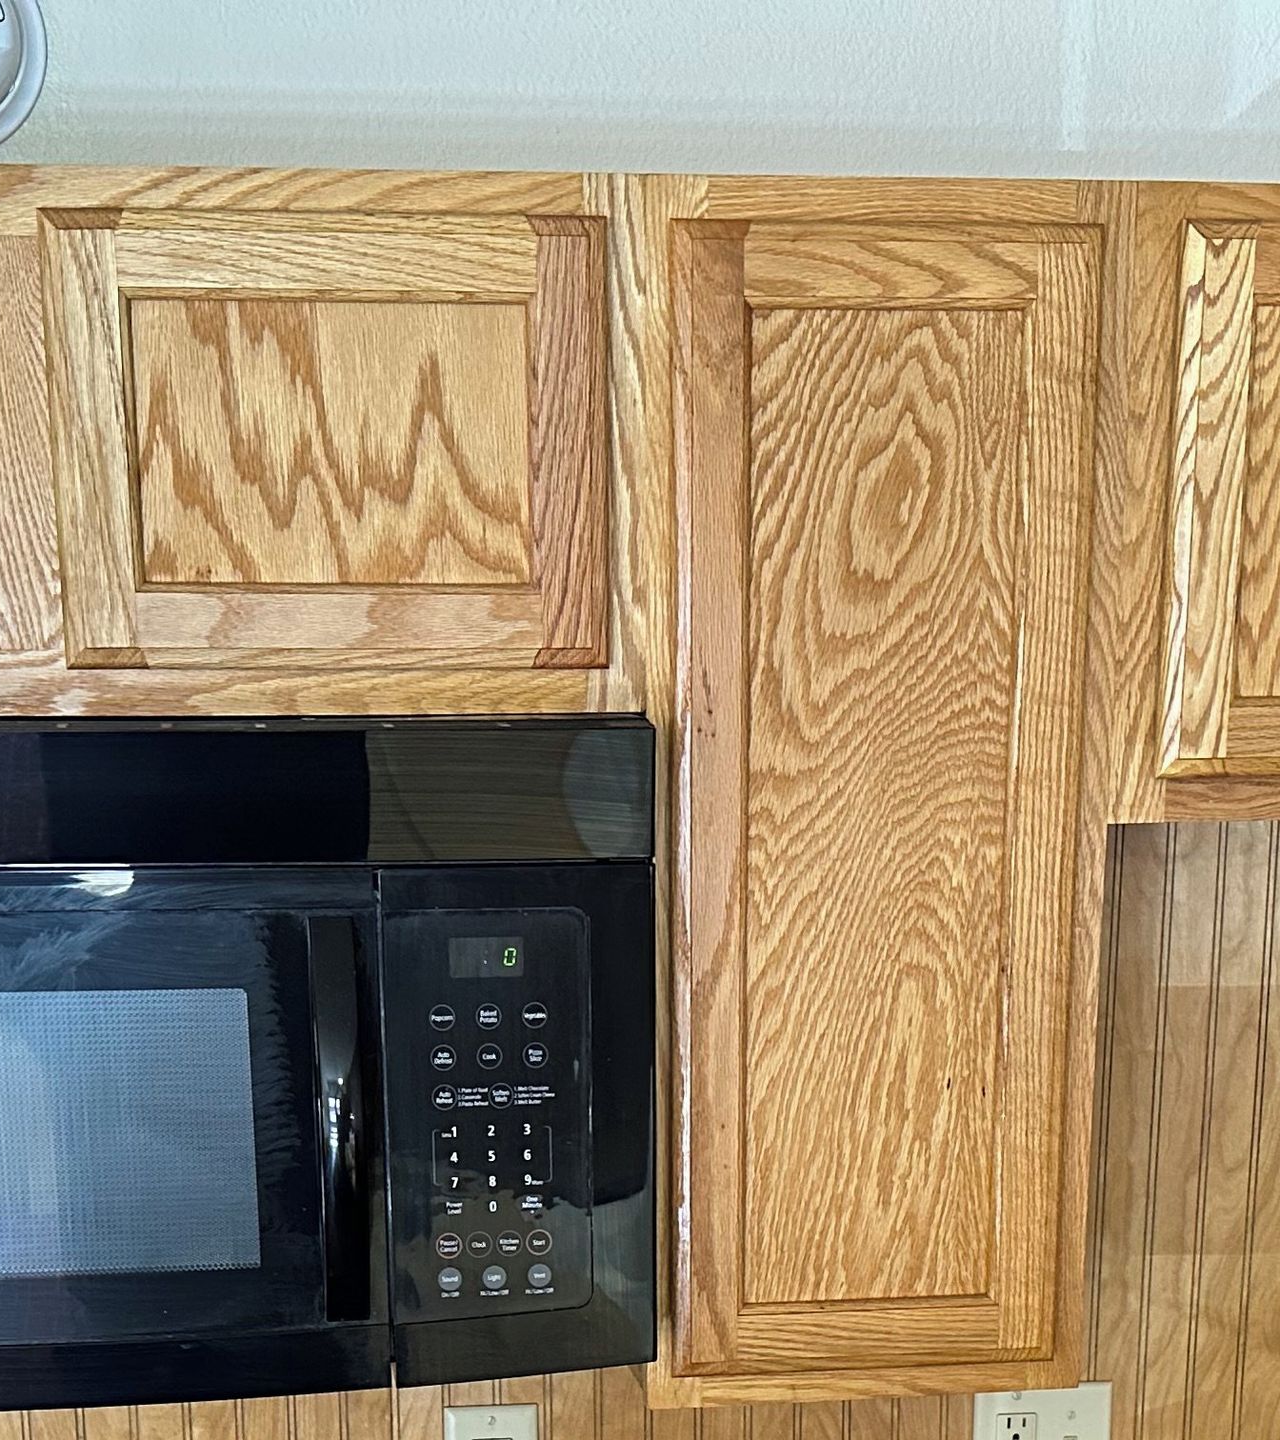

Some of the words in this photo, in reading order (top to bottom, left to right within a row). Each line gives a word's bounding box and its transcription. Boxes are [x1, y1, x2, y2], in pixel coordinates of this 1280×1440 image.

[503, 948, 517, 966] 0
[451, 1126, 457, 1137] 1
[488, 1125, 495, 1136] 2
[524, 1124, 531, 1135] 3
[450, 1152, 458, 1163] 4
[488, 1150, 496, 1162] 5
[524, 1149, 532, 1160] 6
[451, 1177, 458, 1188] 7
[488, 1176, 496, 1187] 8
[524, 1174, 532, 1185] 9
[489, 1201, 497, 1212] 0
